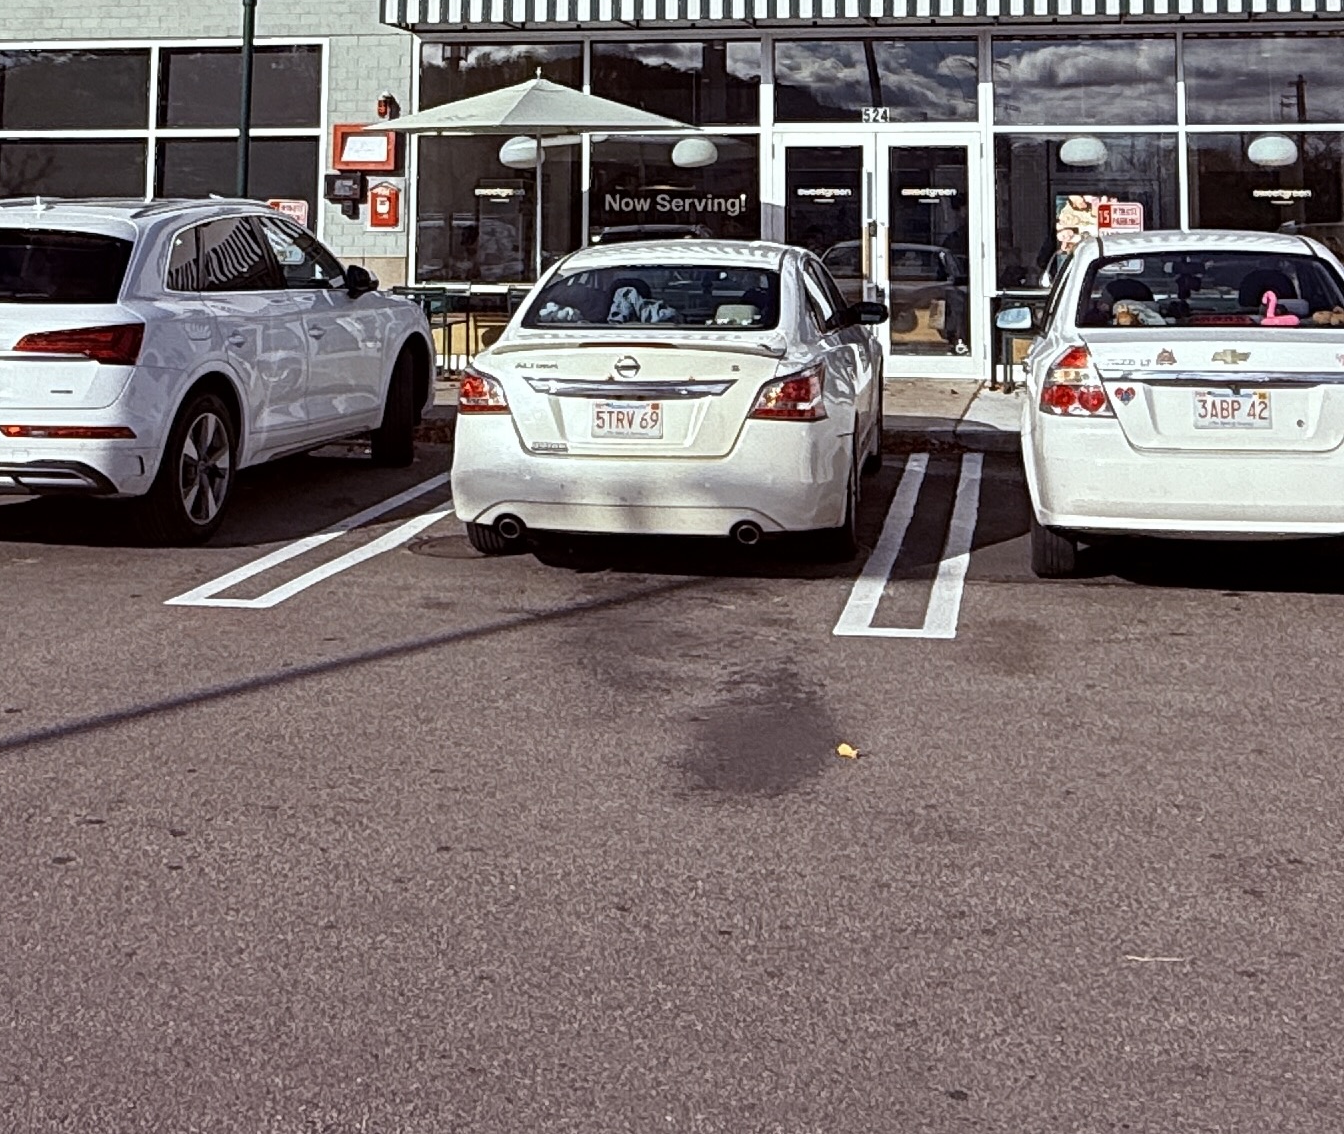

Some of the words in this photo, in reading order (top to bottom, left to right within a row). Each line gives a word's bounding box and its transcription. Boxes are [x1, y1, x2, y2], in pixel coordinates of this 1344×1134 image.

[863, 108, 889, 122] 524
[605, 193, 651, 212] Now
[656, 193, 747, 216] Serving!
[1099, 210, 1110, 224] 15
[1197, 399, 1241, 420] 3ABP
[1247, 400, 1269, 420] 42
[596, 410, 636, 429] 5TRV
[640, 410, 659, 429] 69
